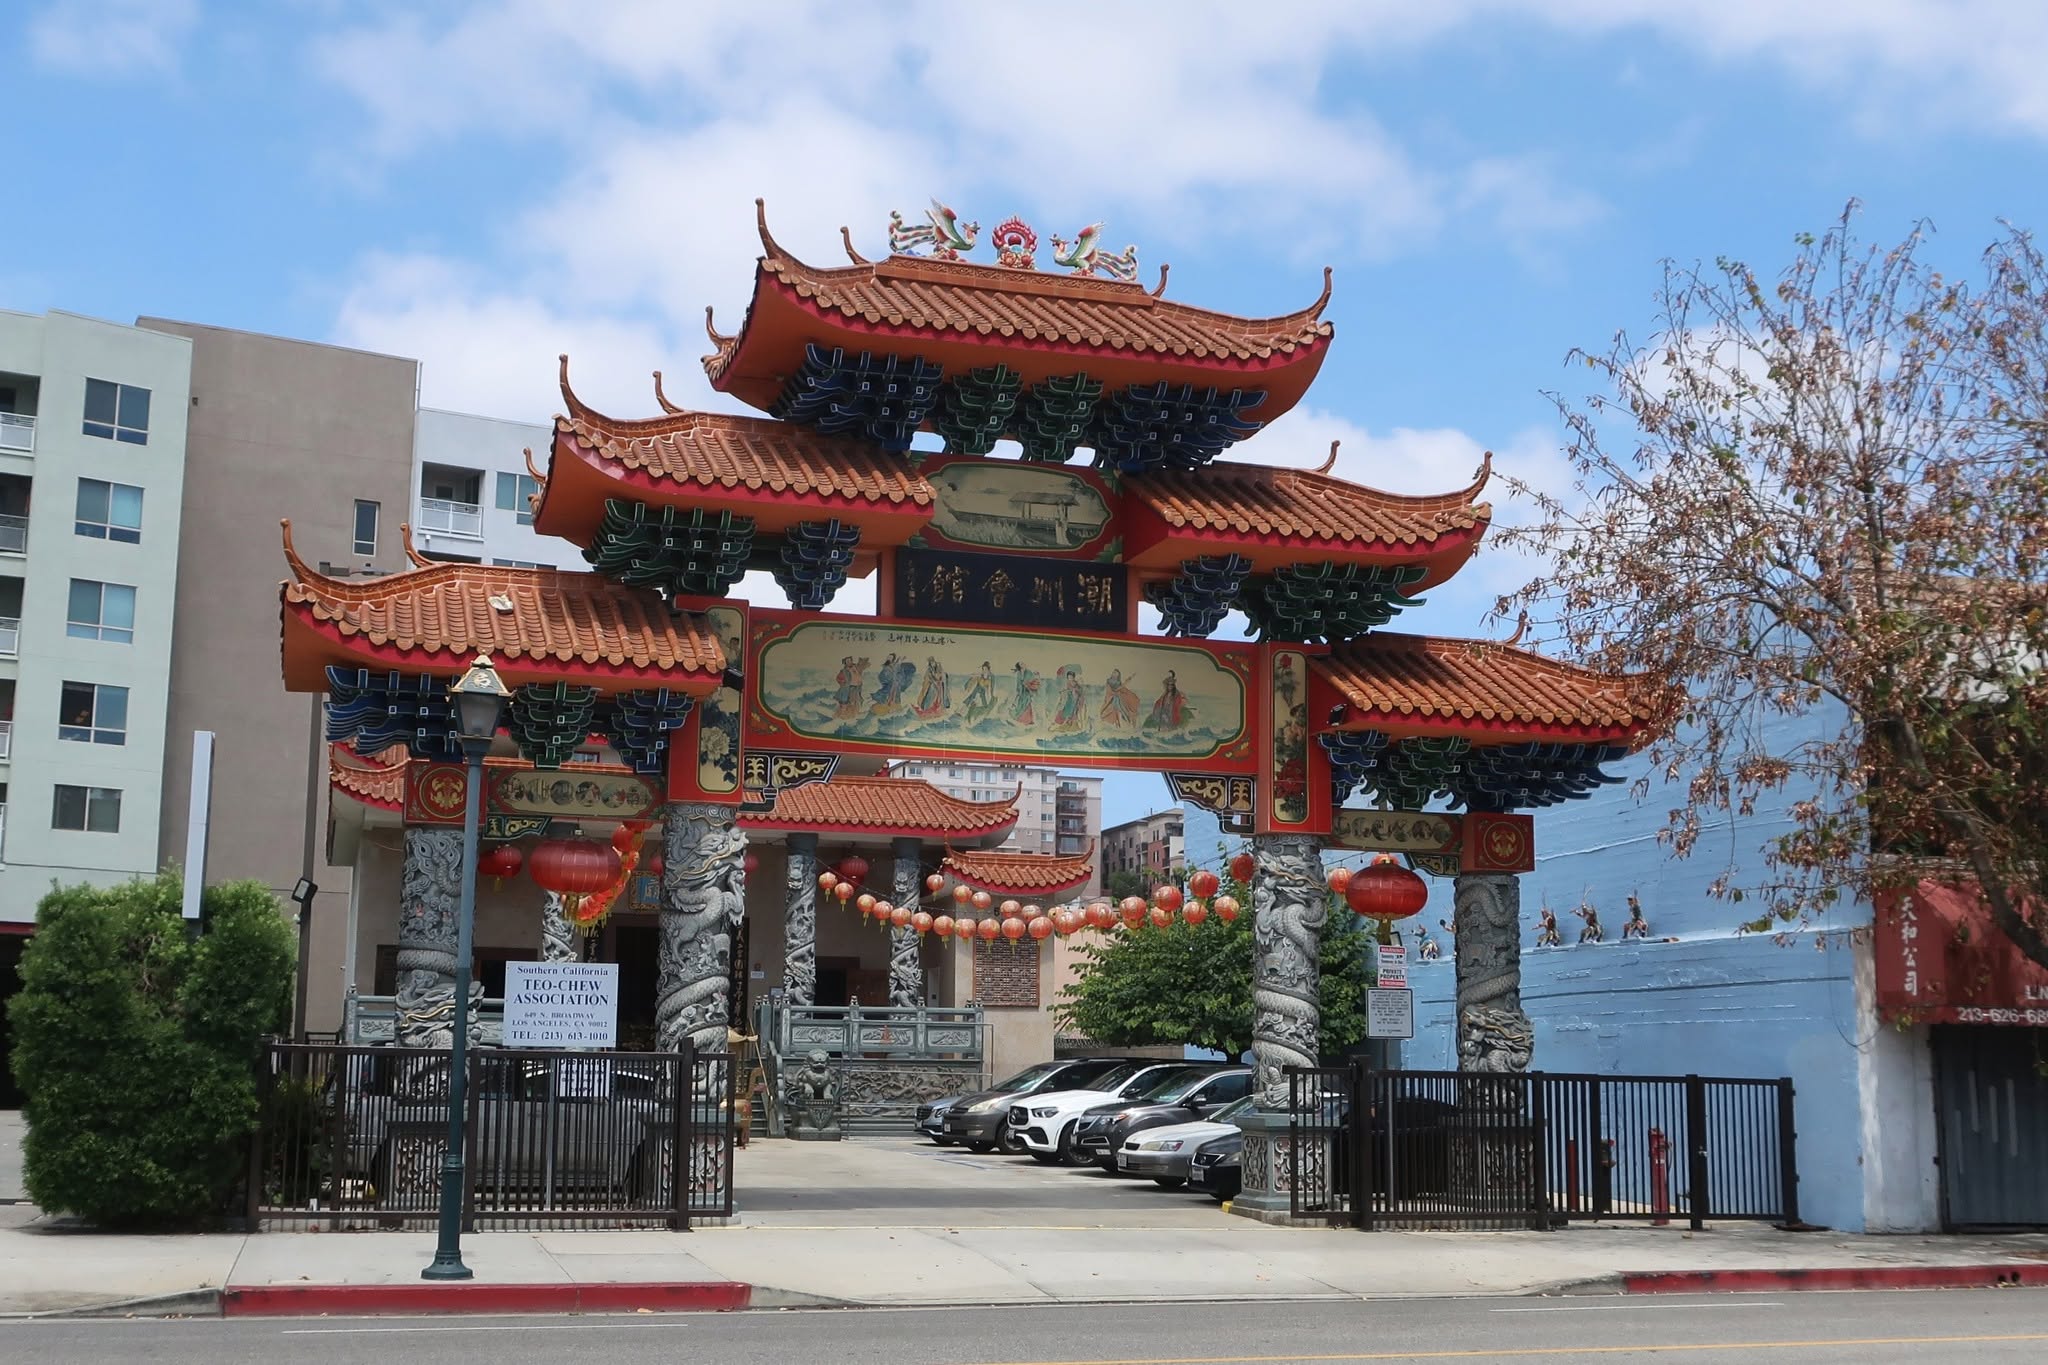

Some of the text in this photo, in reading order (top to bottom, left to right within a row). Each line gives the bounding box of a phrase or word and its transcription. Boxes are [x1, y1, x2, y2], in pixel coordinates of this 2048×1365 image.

[1900, 896, 1918, 996] 天和公司
[516, 966, 609, 976] Southern California
[522, 979, 603, 992] TEO-CHEW
[513, 992, 609, 1006] ASSOCIATION
[1958, 1007, 2048, 1024] 213-626-68
[512, 1031, 608, 1041] TEL: (213) 613-1010
